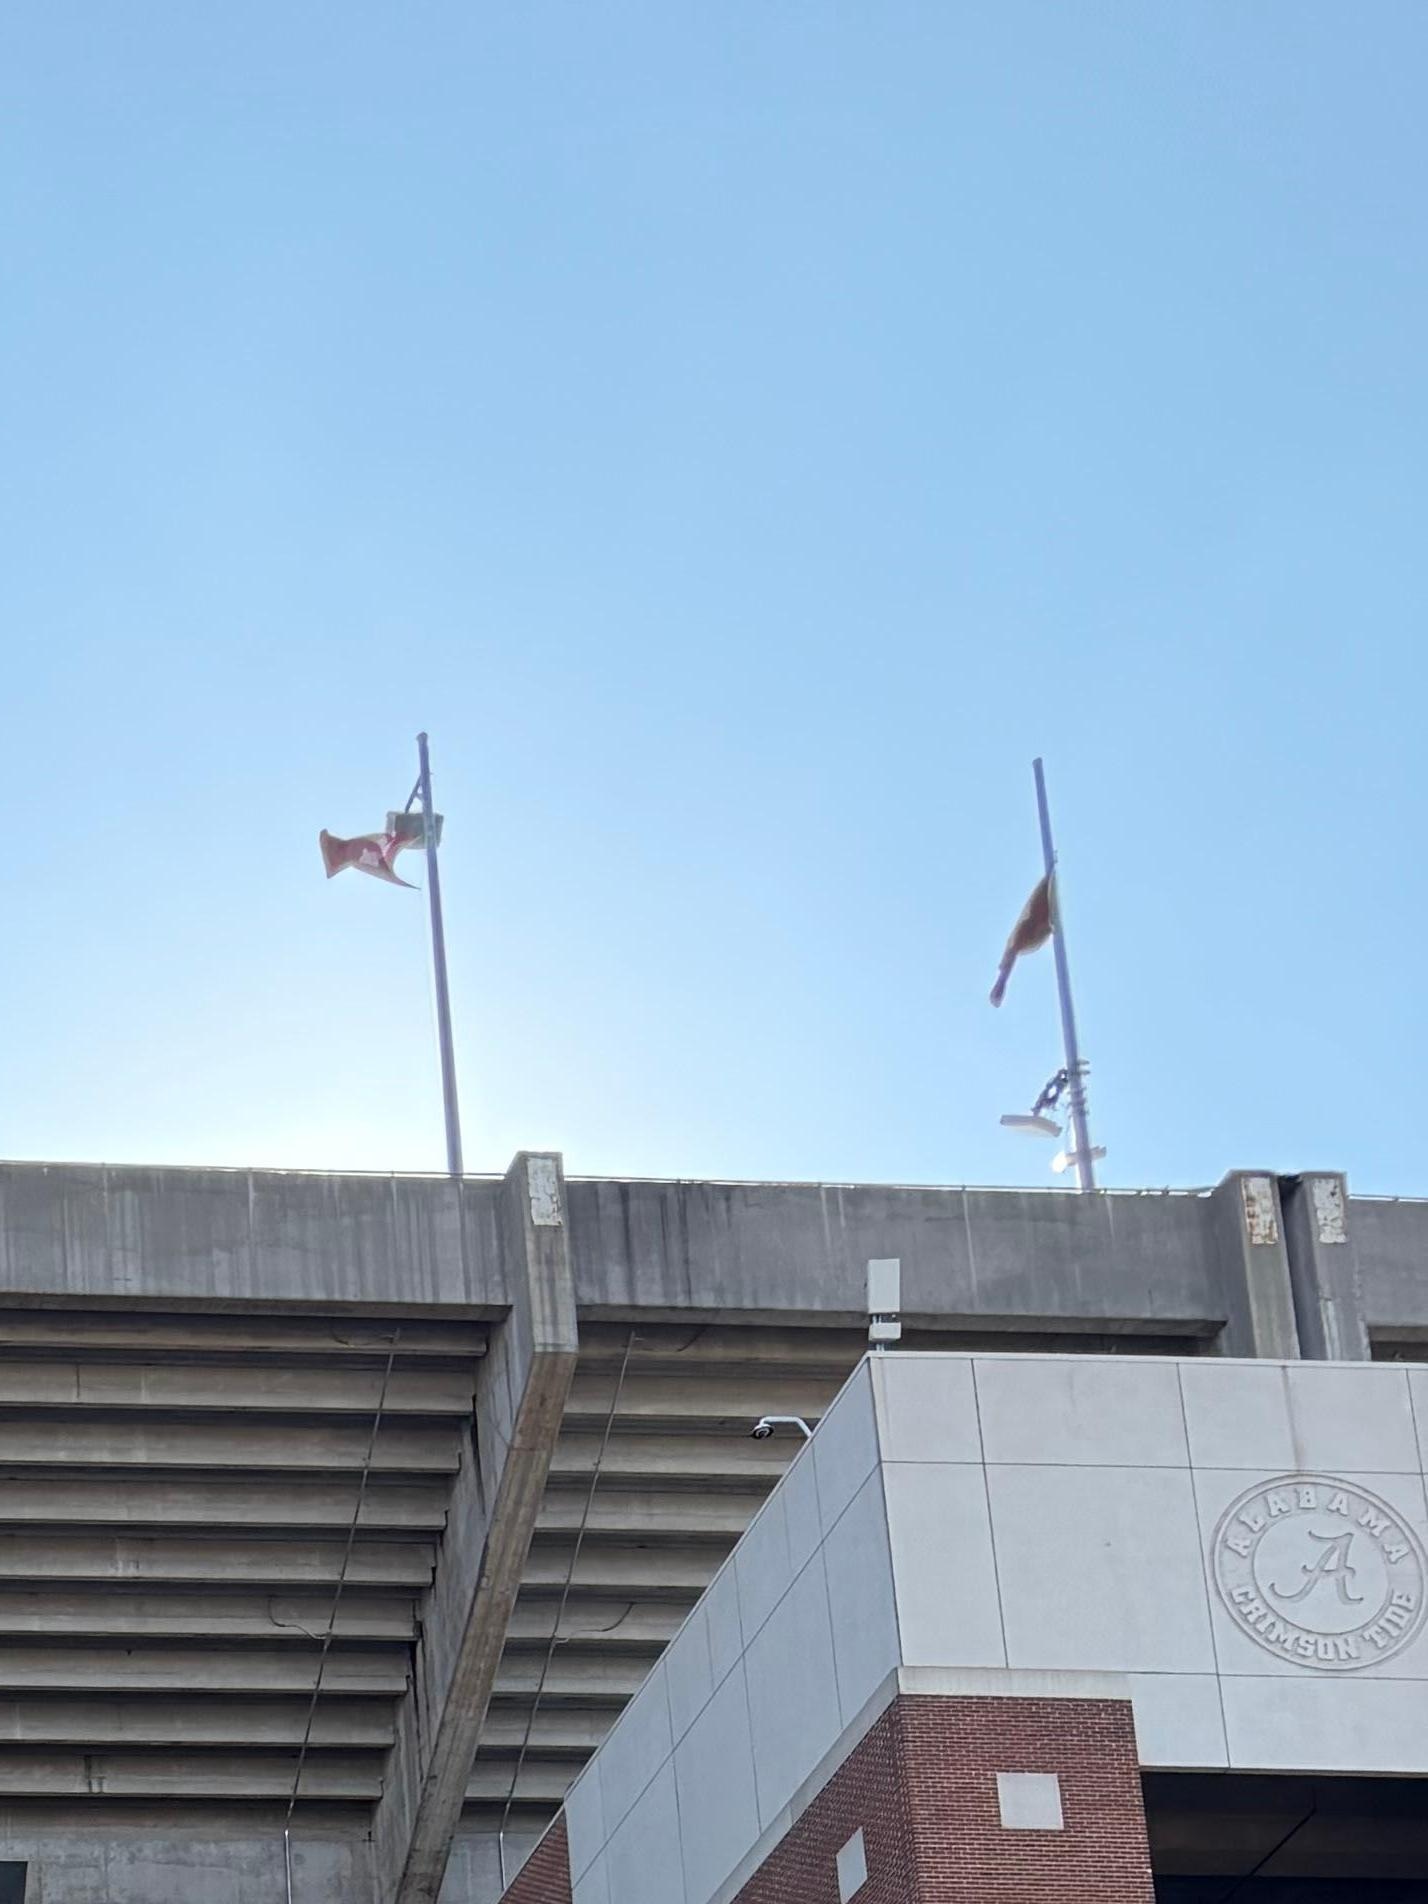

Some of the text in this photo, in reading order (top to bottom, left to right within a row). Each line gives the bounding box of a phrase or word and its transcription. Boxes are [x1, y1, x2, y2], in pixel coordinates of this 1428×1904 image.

[1225, 1487, 1410, 1565] ALABAMA
[1269, 1529, 1364, 1605] A
[1230, 1586, 1362, 1661] CRIMSON
